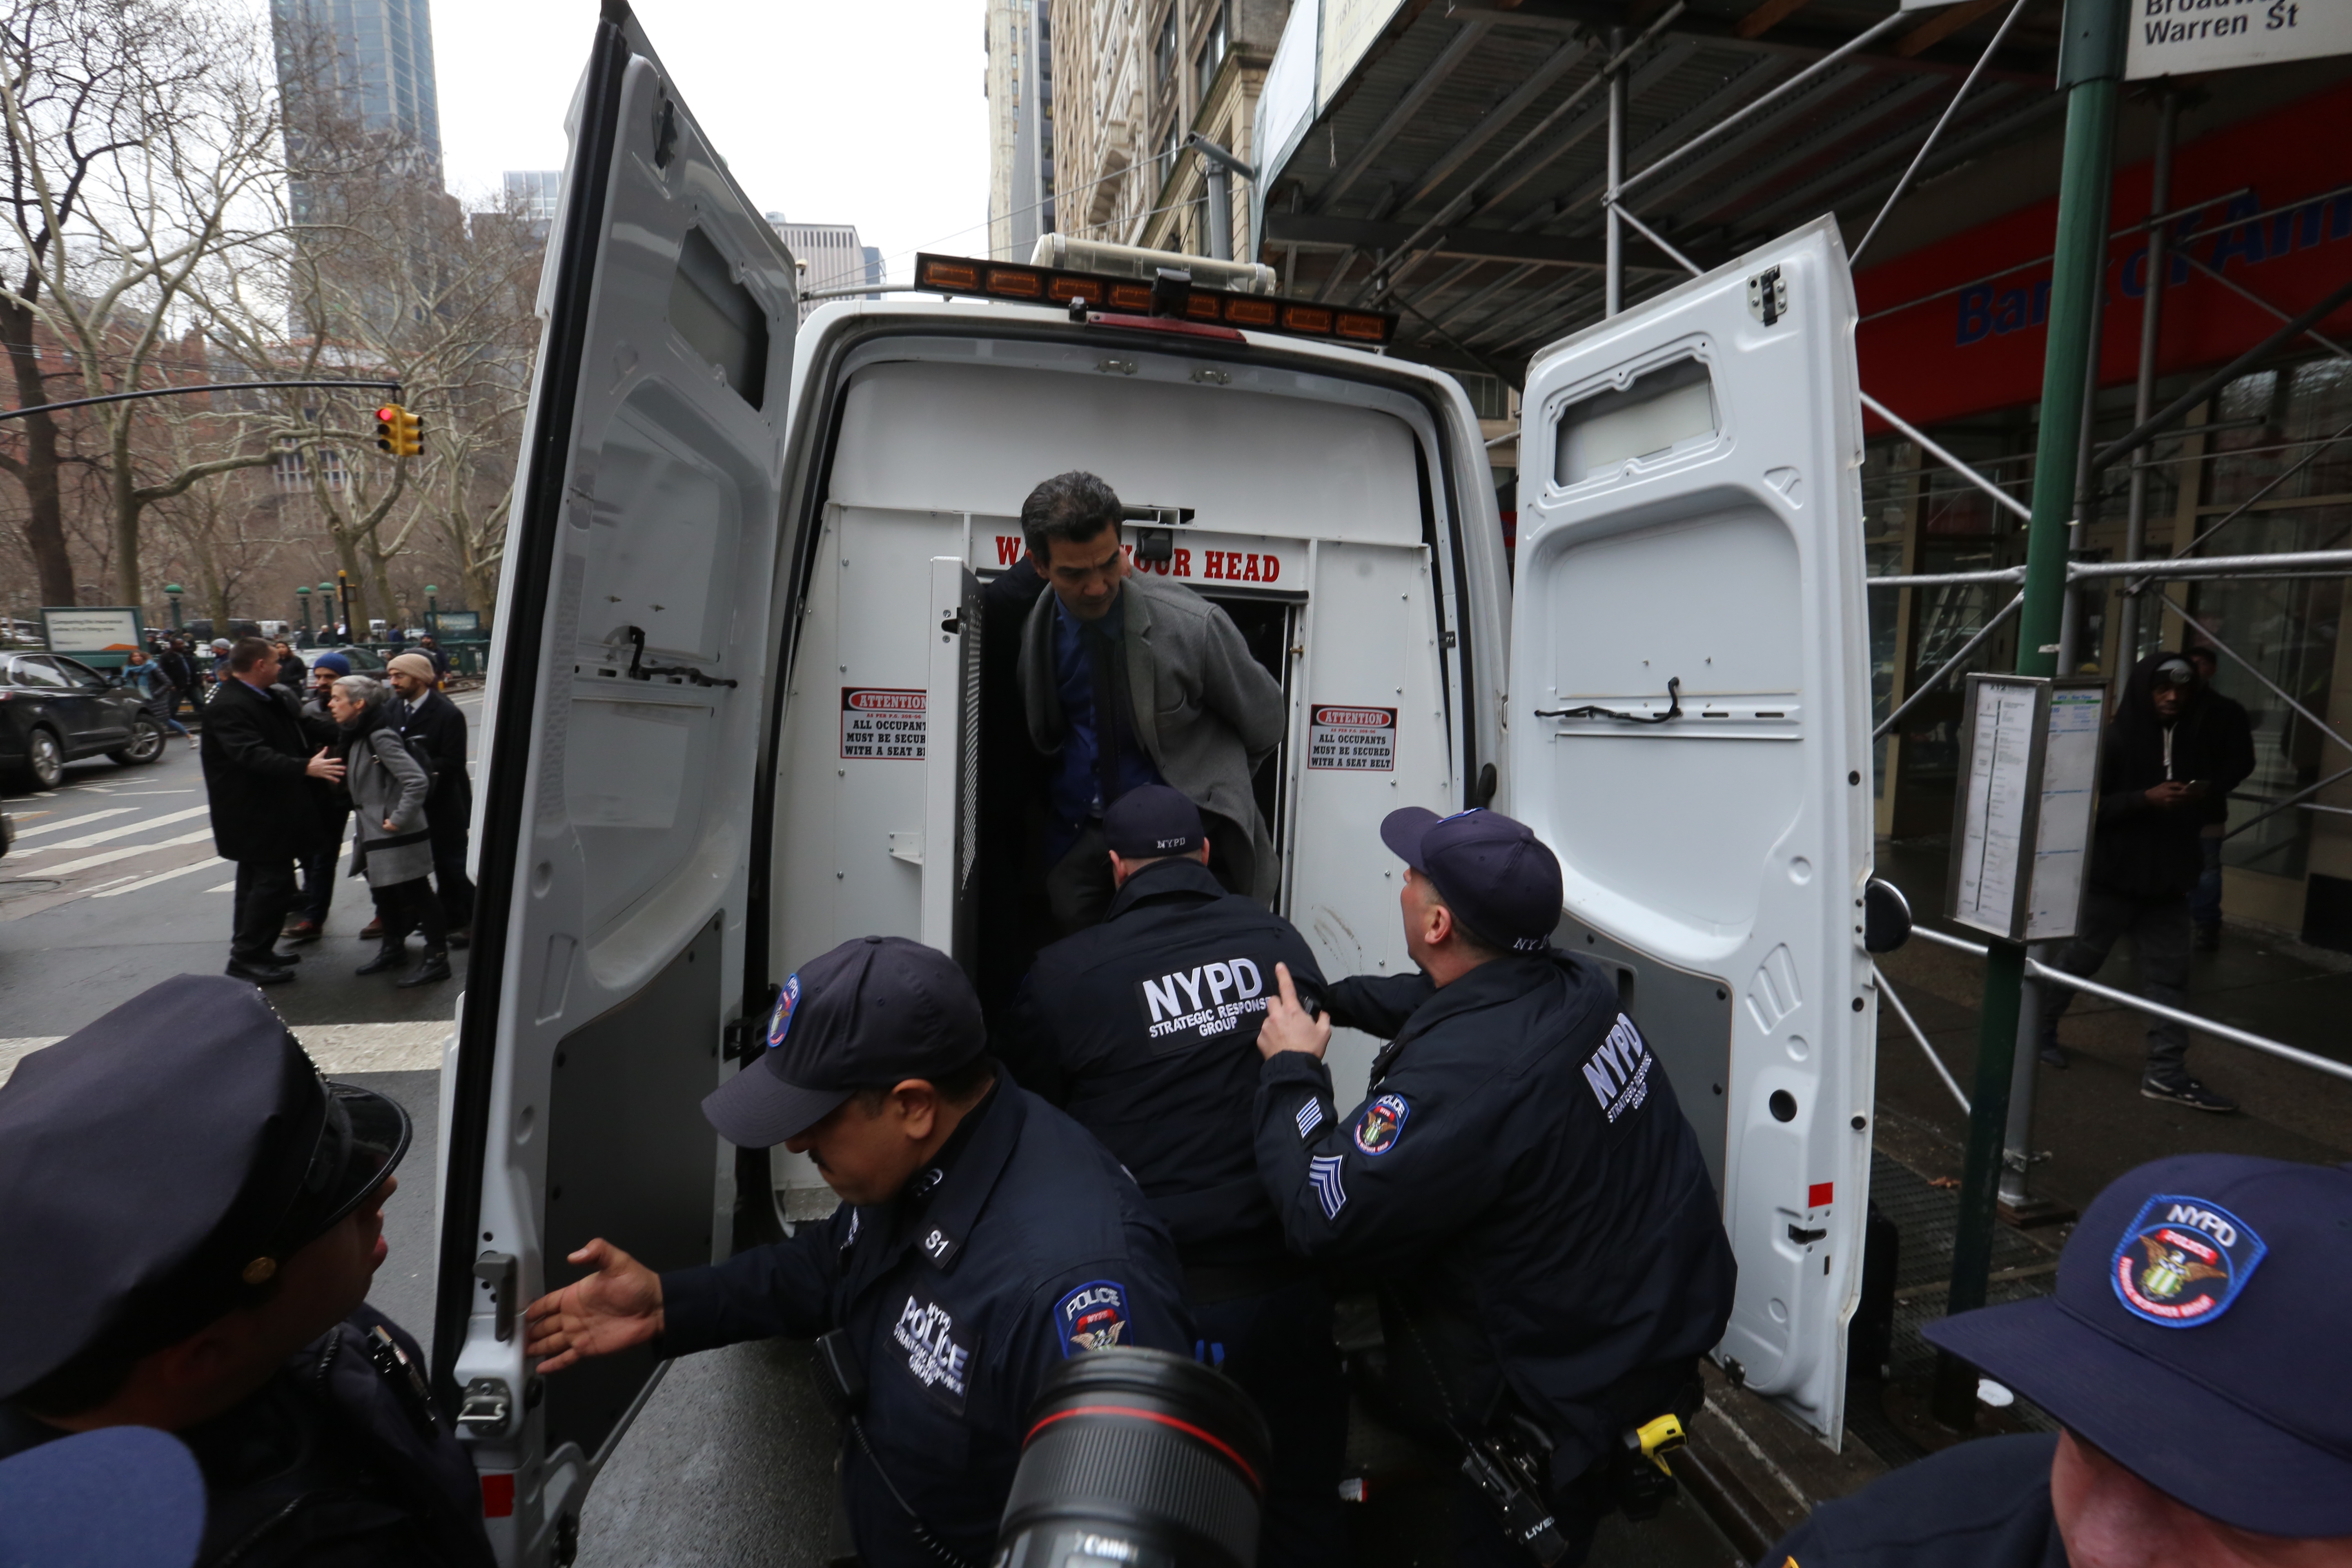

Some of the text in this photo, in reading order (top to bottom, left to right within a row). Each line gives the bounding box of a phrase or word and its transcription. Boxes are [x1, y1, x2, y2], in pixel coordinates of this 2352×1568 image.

[2145, 2, 2299, 45] Warren St
[1956, 260, 2115, 347] Ban
[2121, 211, 2203, 298] of
[1204, 551, 1280, 582] HEAD
[860, 695, 926, 708] ATTENTION
[853, 720, 871, 729] ALL
[1325, 711, 1383, 725] ATTENTION
[845, 746, 872, 755] WITH
[876, 746, 883, 755] A
[887, 746, 912, 756] SEAT
[846, 733, 873, 742] MUST
[878, 734, 891, 742] BE
[1313, 746, 1390, 756] MUST BE SECURED
[1319, 734, 1386, 745] ALL OCCUPANTS
[1312, 757, 1334, 766] WITH
[1346, 759, 1367, 767] SEAT
[1370, 760, 1391, 768] BELT
[1157, 837, 1185, 849] NYPD
[1142, 958, 1262, 1023] NYPD
[1149, 1009, 1214, 1038] STRATEGIC
[1199, 1016, 1237, 1037] GROUP
[1582, 1012, 1643, 1110] NYPD
[1376, 1095, 1405, 1118] POLICE
[1607, 1080, 1637, 1123] STRATEGIC
[2166, 1204, 2237, 1247] NYPD
[925, 1229, 949, 1258] S1
[926, 1302, 952, 1332] NYPD
[1066, 1287, 1120, 1322] POLICE
[900, 1295, 969, 1381] POLICE
